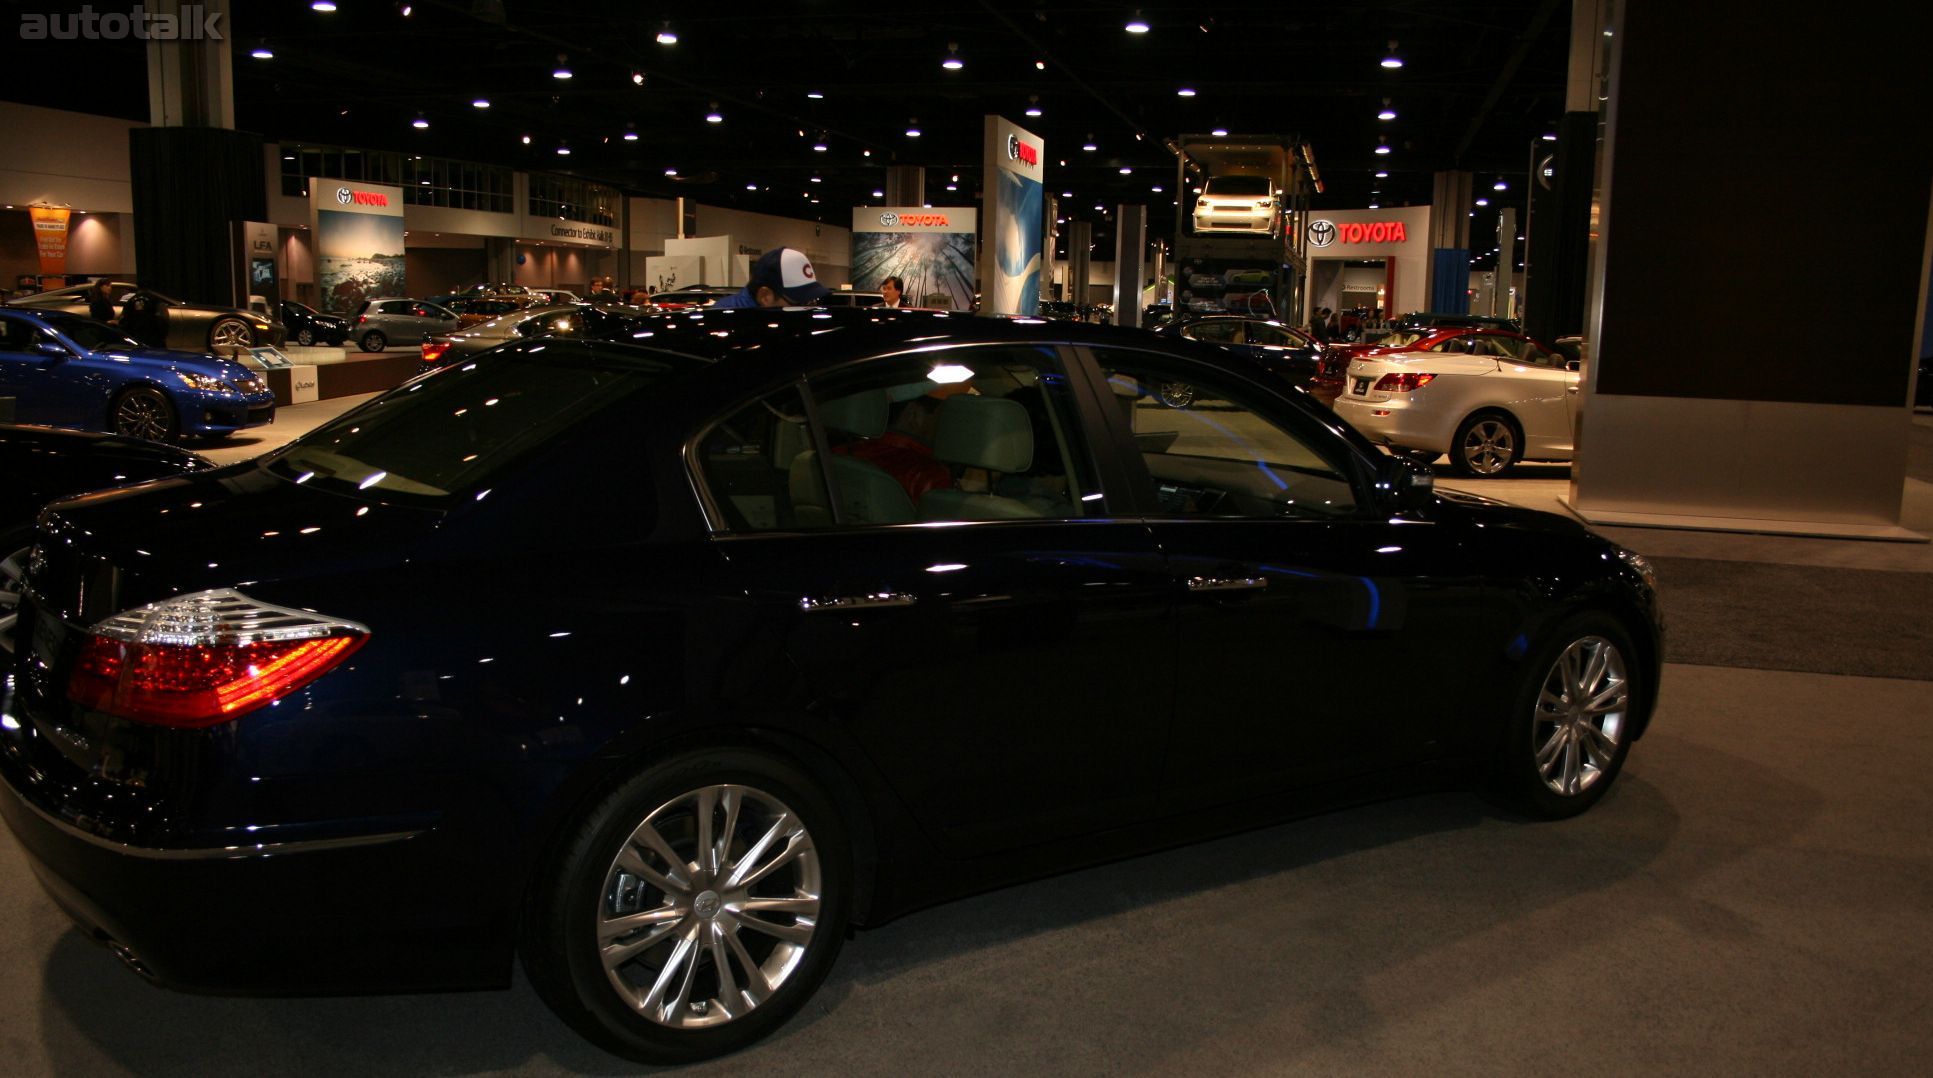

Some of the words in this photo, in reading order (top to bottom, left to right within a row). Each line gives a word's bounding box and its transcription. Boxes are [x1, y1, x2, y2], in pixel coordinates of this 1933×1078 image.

[353, 191, 387, 206] TOYOTA
[899, 213, 949, 227] TOYOTA
[551, 224, 576, 238] Connector
[1337, 221, 1407, 243] TOYOTA
[253, 240, 272, 250] LFA
[802, 263, 814, 279] C
